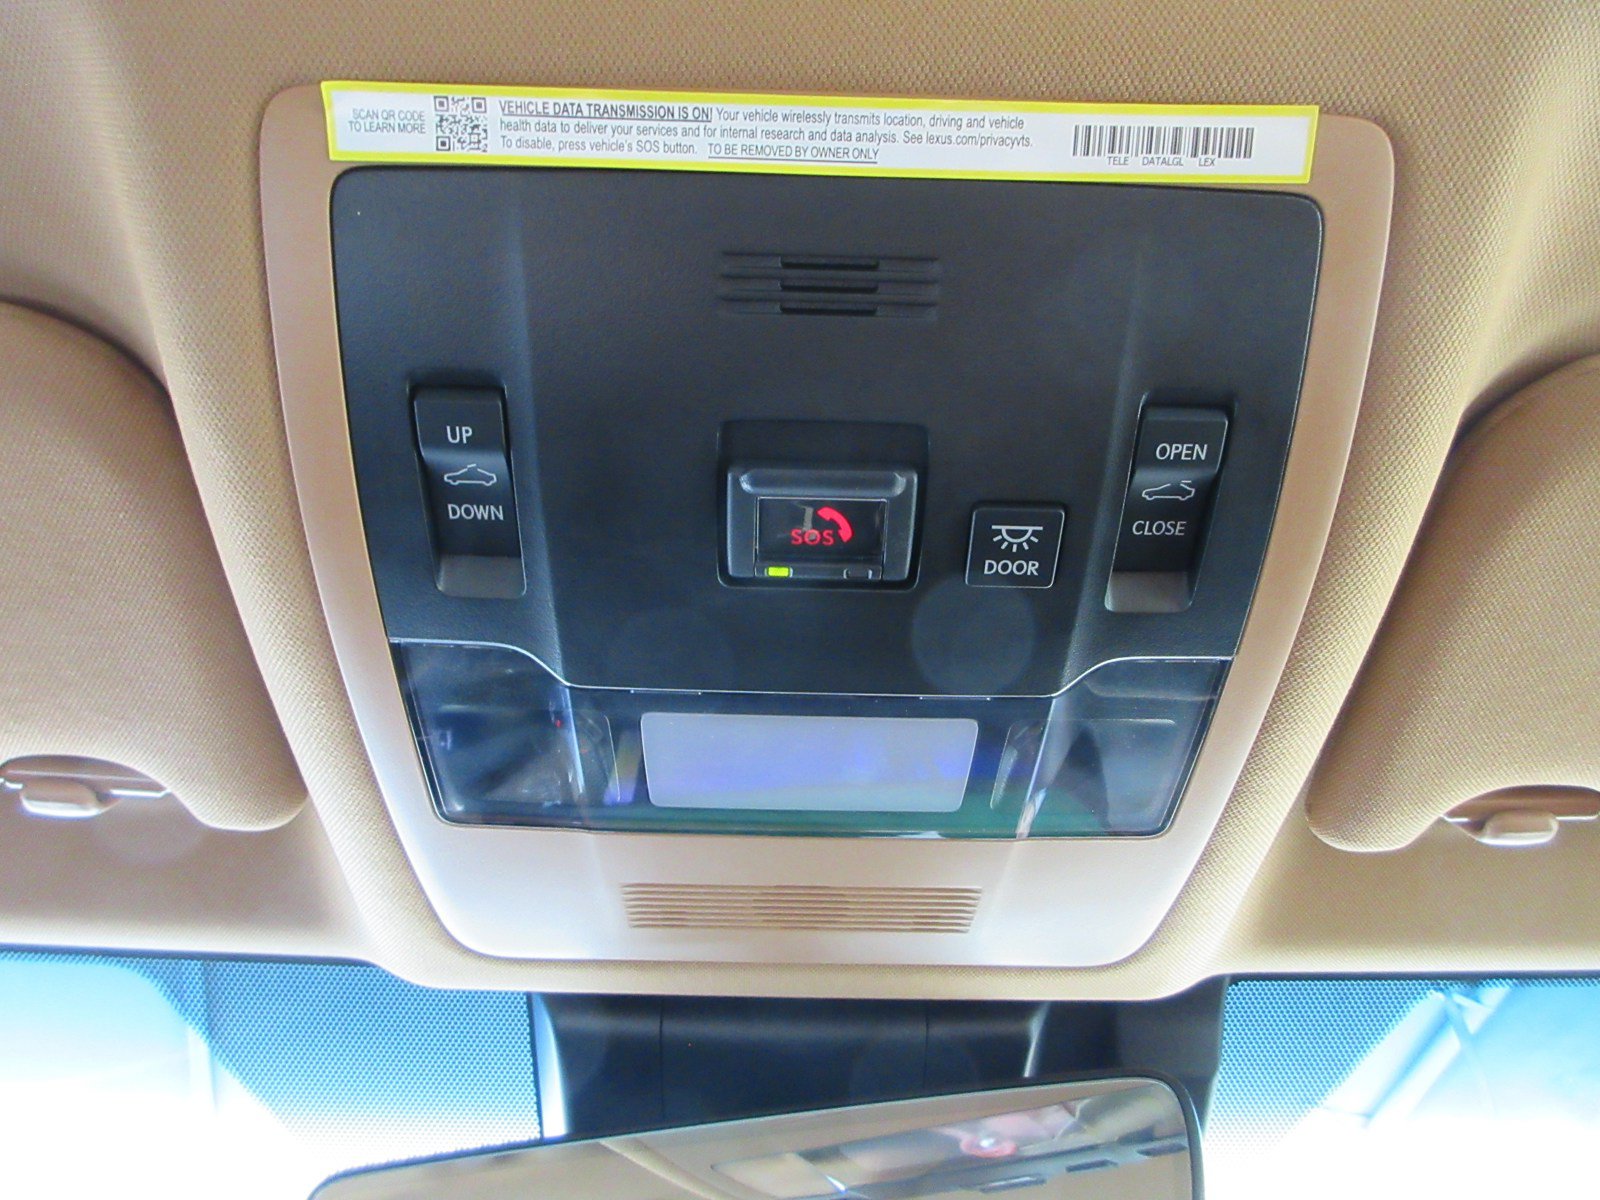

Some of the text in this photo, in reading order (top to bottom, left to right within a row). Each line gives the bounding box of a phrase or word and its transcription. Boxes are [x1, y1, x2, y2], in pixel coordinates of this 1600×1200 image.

[352, 108, 379, 120] SCAN
[398, 110, 425, 122] CODE
[499, 100, 1024, 131] VEHICLE DATA TRANSMISSION IS ON! Your vehicle wirelessly transmits location, driving and vehicle
[348, 121, 426, 134] TO LEARN MORE
[500, 118, 531, 132] health
[534, 119, 557, 133] data
[561, 121, 570, 133] to
[574, 121, 608, 134] deliver
[611, 124, 633, 138] your
[636, 124, 678, 137] services
[681, 125, 700, 137] and
[703, 125, 717, 138] for
[720, 125, 758, 139] internal
[761, 127, 805, 140] research
[808, 128, 827, 141] and
[831, 129, 852, 142] data
[856, 130, 899, 145] analysis.
[903, 131, 923, 144] See
[501, 135, 879, 160] To disable, press vehicle's SOS button. TO BE REMOVED BY OWNER ONLY
[1107, 156, 1216, 167] TELE DATALGL LEX
[446, 425, 473, 444] UP
[1155, 443, 1208, 461] OPEN
[447, 503, 504, 521] DOWN
[1132, 520, 1187, 536] CLOSE
[790, 529, 834, 546] SOS
[983, 559, 1040, 576] DOOR
